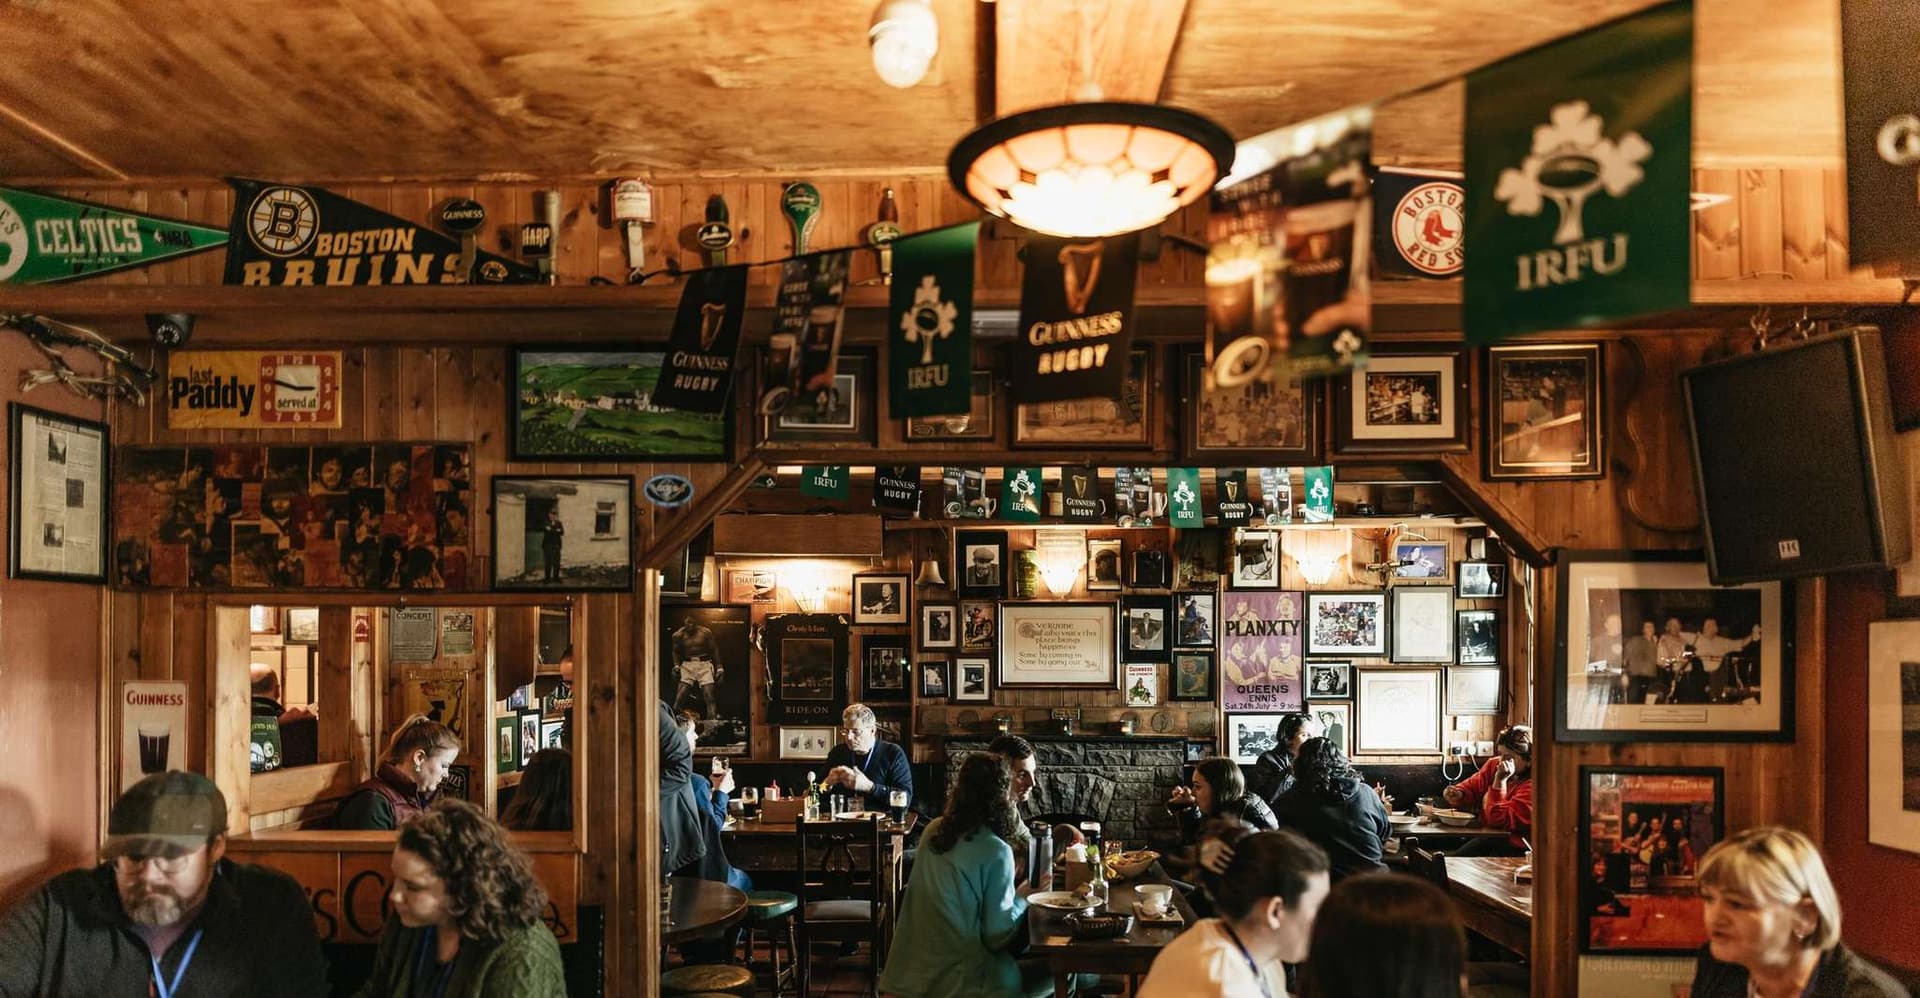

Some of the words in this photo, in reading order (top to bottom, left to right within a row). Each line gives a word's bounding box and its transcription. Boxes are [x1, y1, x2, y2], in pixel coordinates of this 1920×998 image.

[443, 209, 483, 220] GUINNESS
[35, 217, 143, 253] CELTICS
[314, 228, 416, 256] BOSTON
[522, 226, 550, 247] HARP
[1407, 242, 1437, 267] RED
[1444, 243, 1464, 265] SO
[1516, 234, 1629, 291] IRFU
[1029, 310, 1123, 346] GUINNESS
[672, 351, 729, 371] GUINNESS
[1038, 344, 1109, 374] RUGBY
[189, 365, 213, 383] last
[262, 367, 274, 376] 10
[907, 363, 949, 390] IRFU
[674, 375, 720, 392] RUGBY
[171, 375, 255, 417] Paddy
[277, 396, 306, 408] served
[308, 397, 316, 408] at
[814, 476, 837, 489] IRFU
[879, 476, 916, 490] GUINNESS
[883, 490, 911, 500] RUGBY
[1066, 498, 1096, 507] GUINNESS
[1071, 508, 1094, 517] RUGBY
[1220, 502, 1246, 511] GUINNESS
[1177, 511, 1194, 519] IRFU
[1225, 511, 1244, 519] RUGBY
[1225, 620, 1300, 636] PLANXTY
[1237, 685, 1289, 694] QUEENS
[126, 690, 183, 706] GUINNESS
[1249, 694, 1276, 702] ENNIS
[1255, 702, 1270, 710] July
